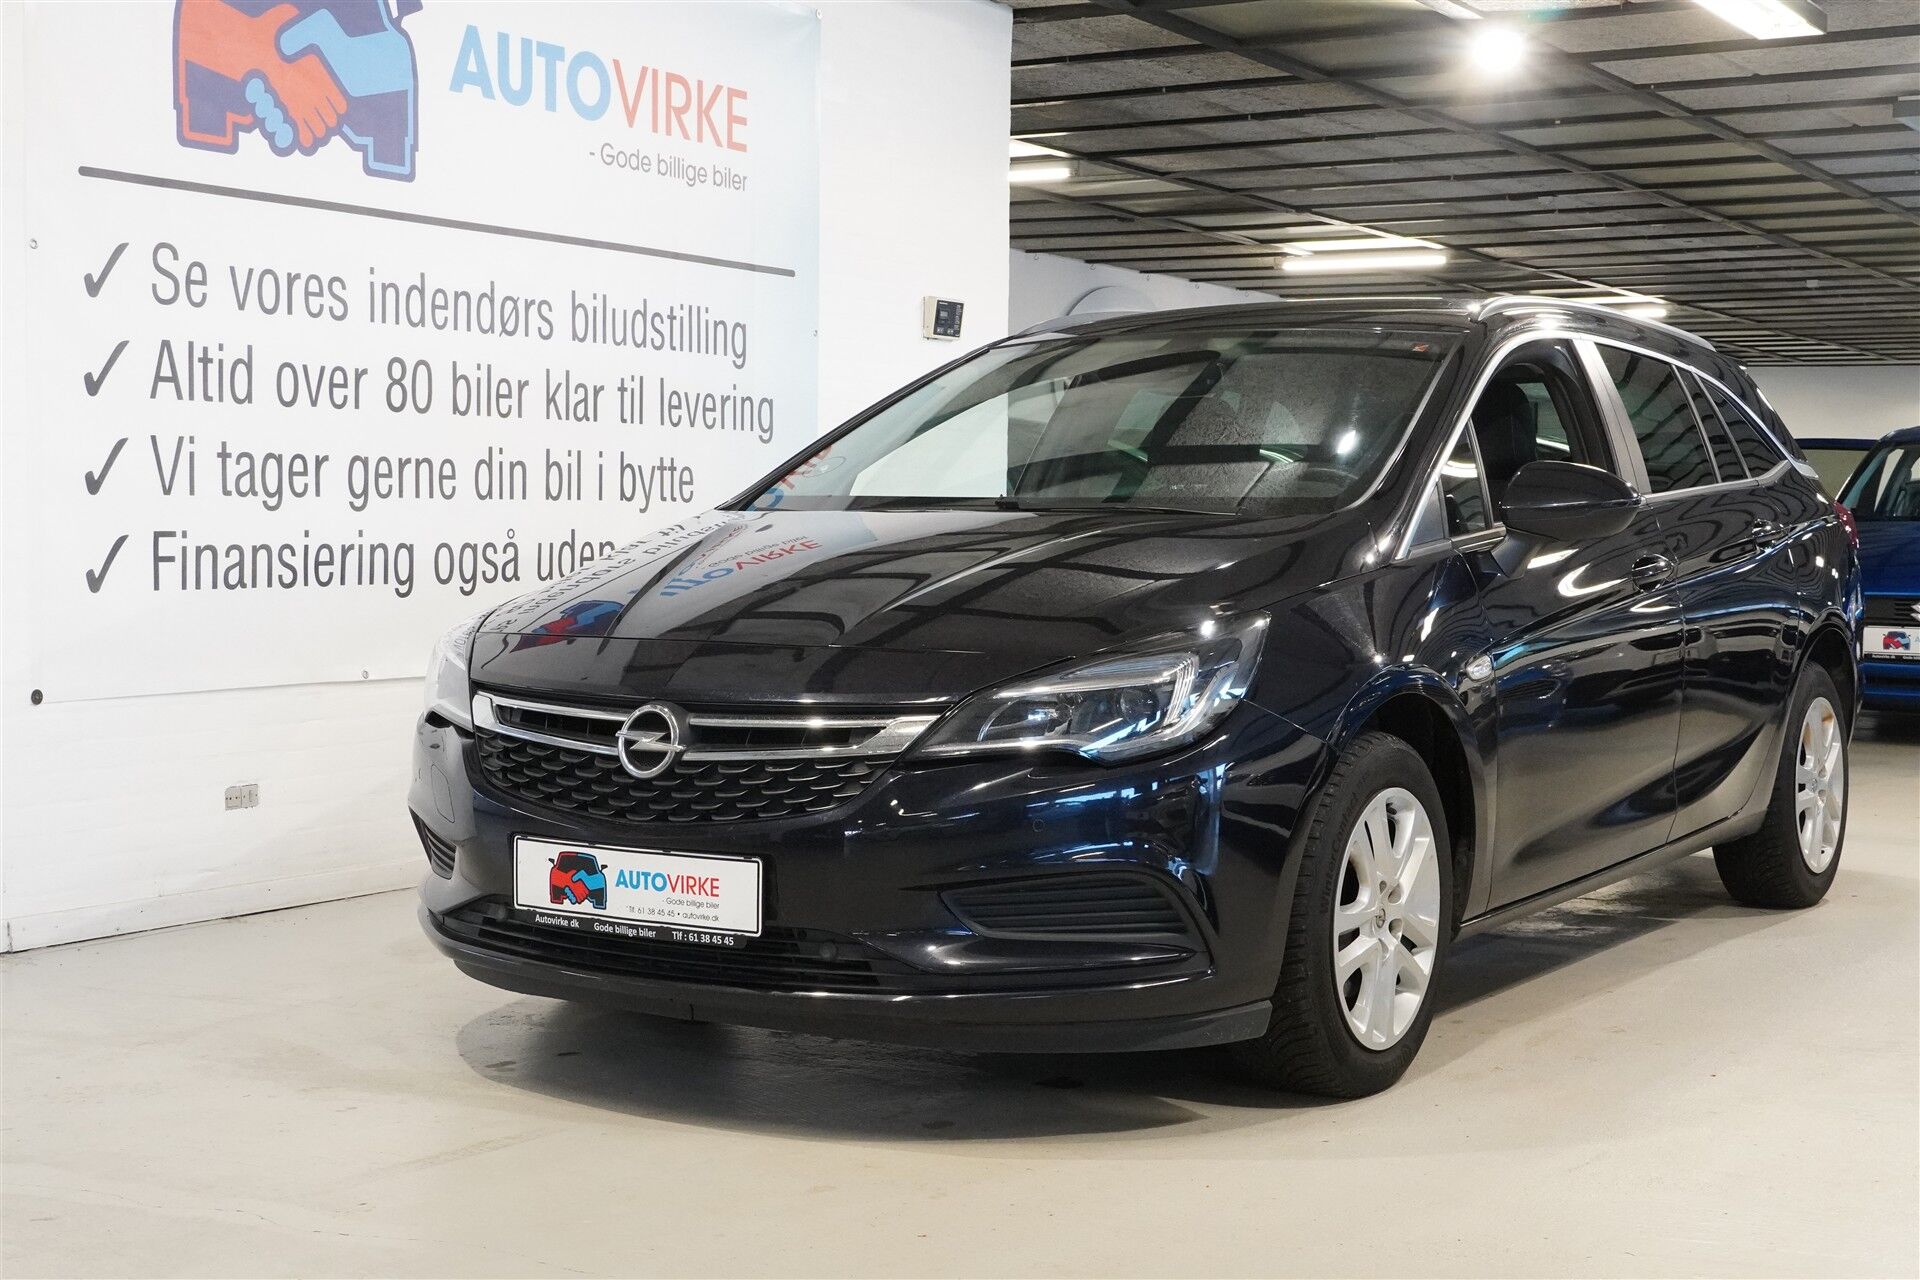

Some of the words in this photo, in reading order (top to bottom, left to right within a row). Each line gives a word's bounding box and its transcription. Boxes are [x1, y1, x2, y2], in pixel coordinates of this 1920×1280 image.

[449, 24, 748, 153] AUTOVIRKE
[600, 142, 652, 174] Gode
[656, 152, 708, 187] billige
[713, 164, 748, 192] biler
[152, 242, 208, 307] Se
[230, 266, 349, 321] vores
[370, 267, 554, 340] indendørs
[572, 291, 747, 369] biludstilling
[150, 340, 254, 404] Altid
[277, 362, 369, 409] over
[386, 357, 433, 414] 80
[453, 361, 530, 418] biler
[546, 369, 605, 422] klar
[618, 376, 644, 424] til
[660, 378, 774, 444] levering
[151, 435, 195, 496] Vi
[217, 441, 330, 511] tager
[348, 455, 457, 512] gerne
[475, 447, 527, 500] din
[546, 449, 582, 501] bil
[598, 450, 604, 501] i
[620, 451, 694, 513] bytte
[153, 530, 415, 598] Finansiering
[434, 529, 521, 596] også
[615, 869, 720, 897] AUTOVIRKE
[648, 907, 656, 915] 38
[657, 909, 666, 917] 45
[667, 910, 676, 918] 45
[665, 897, 685, 906] Gode
[686, 900, 705, 910] billige
[706, 902, 720, 910] biler
[593, 922, 614, 934] Gode
[614, 924, 637, 937] billige
[638, 927, 657, 938] biler
[688, 933, 699, 942] 61
[700, 934, 711, 944] 38
[711, 935, 722, 945] 45
[723, 936, 735, 946] 45
